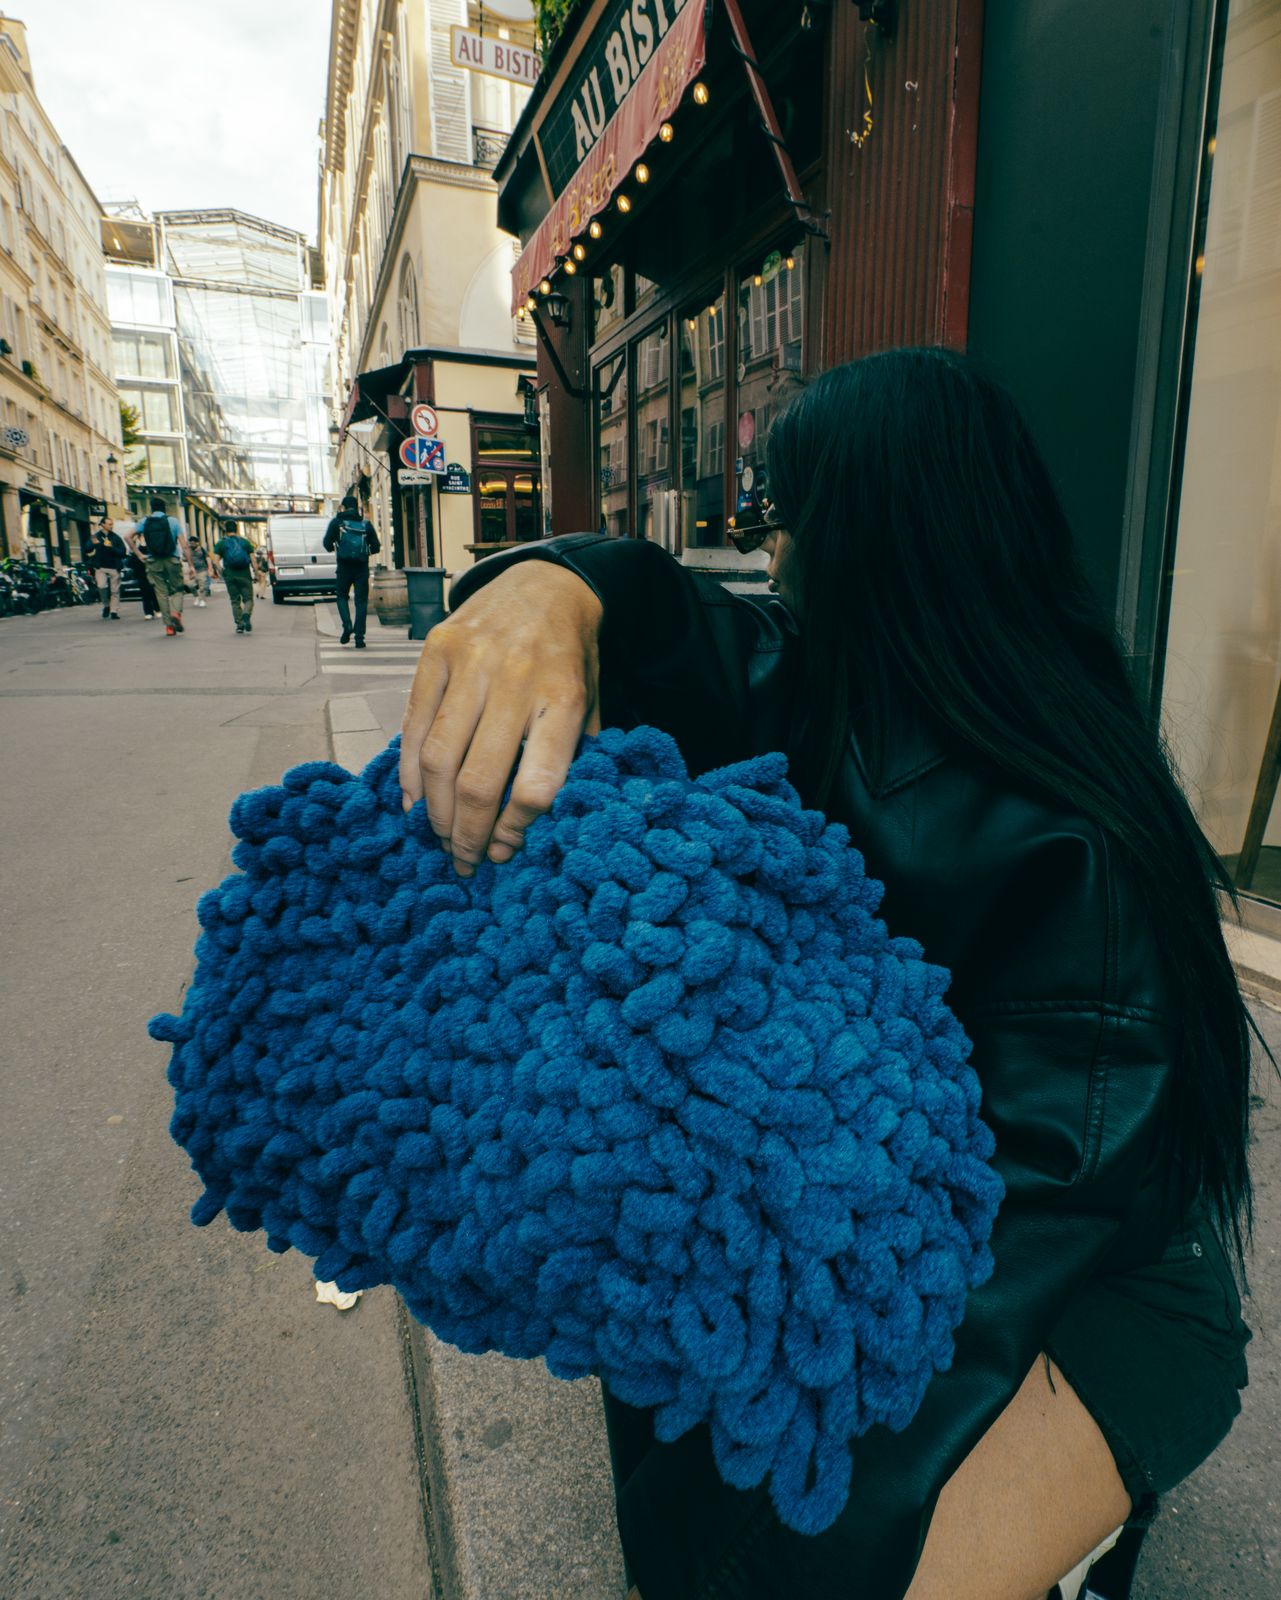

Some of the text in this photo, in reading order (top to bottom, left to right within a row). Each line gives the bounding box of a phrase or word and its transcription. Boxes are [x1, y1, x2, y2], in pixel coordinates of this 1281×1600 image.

[458, 35, 484, 65] AU
[571, 66, 605, 162] AU
[605, 0, 685, 105] BIS
